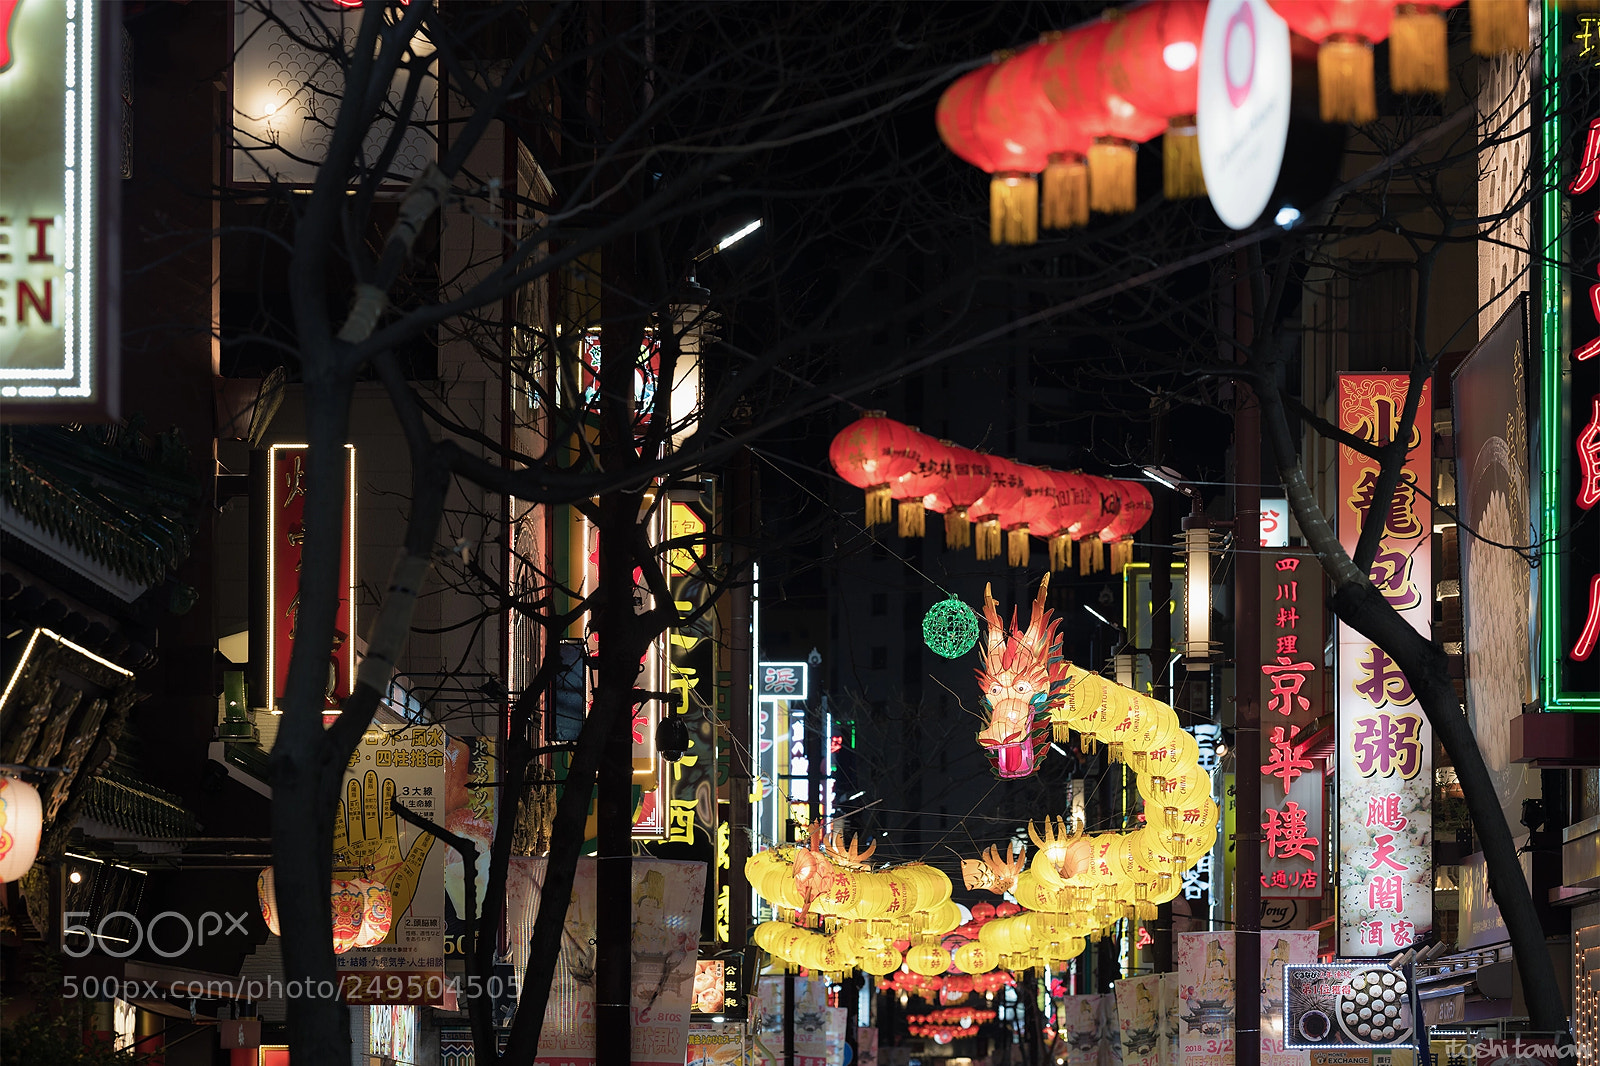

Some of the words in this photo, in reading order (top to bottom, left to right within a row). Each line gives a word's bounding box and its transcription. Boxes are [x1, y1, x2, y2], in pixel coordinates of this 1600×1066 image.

[1275, 558, 1300, 654] 四川料理
[765, 667, 798, 693] 浜
[472, 740, 489, 820] 北京ダック
[1261, 656, 1320, 861] 京華樓
[402, 786, 433, 796] 3大線
[1360, 920, 1415, 947] 酒家
